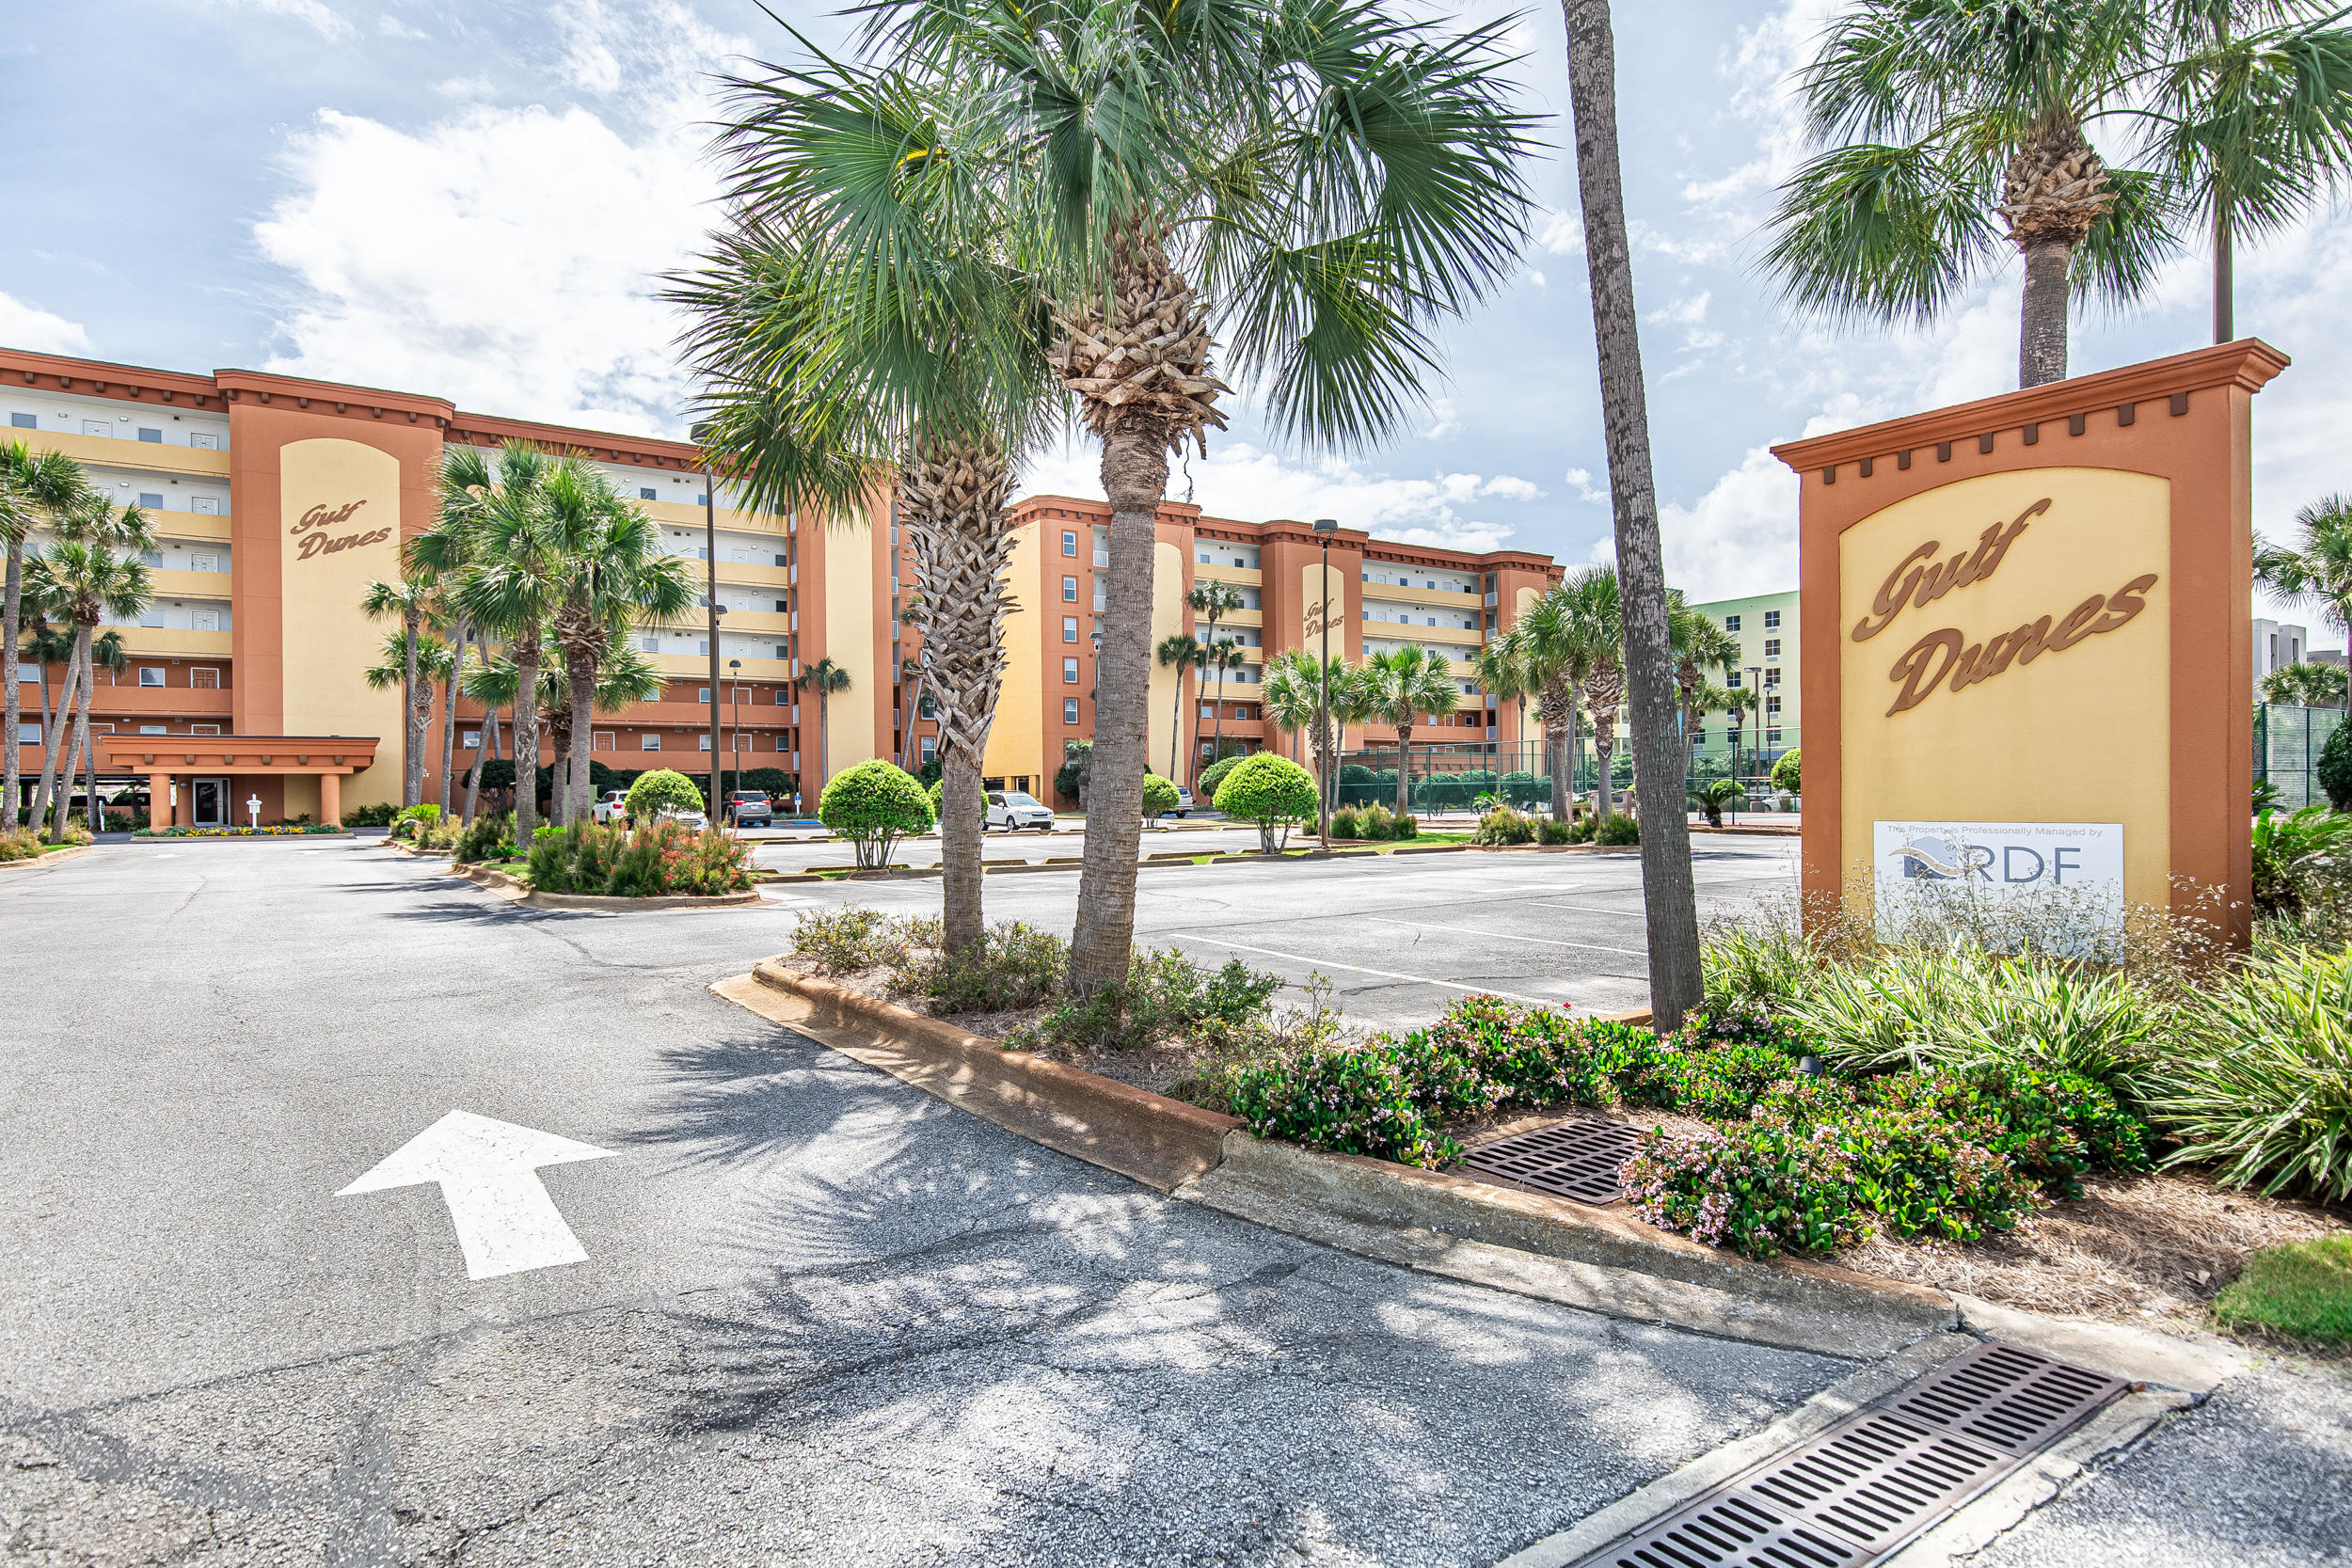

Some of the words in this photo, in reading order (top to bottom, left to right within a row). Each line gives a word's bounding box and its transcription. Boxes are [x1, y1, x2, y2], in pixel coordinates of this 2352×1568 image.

[290, 499, 367, 534] Gulf
[296, 527, 392, 561] Dunes
[1851, 498, 2052, 641] Gulf
[1304, 597, 1335, 622] Guf
[1305, 615, 1344, 639] Dues
[1885, 573, 2158, 717] Dunes
[1962, 826, 2032, 836] Professionally
[2035, 827, 2086, 836] Managed
[2090, 828, 2104, 838] by
[1964, 845, 2082, 885] RDF
